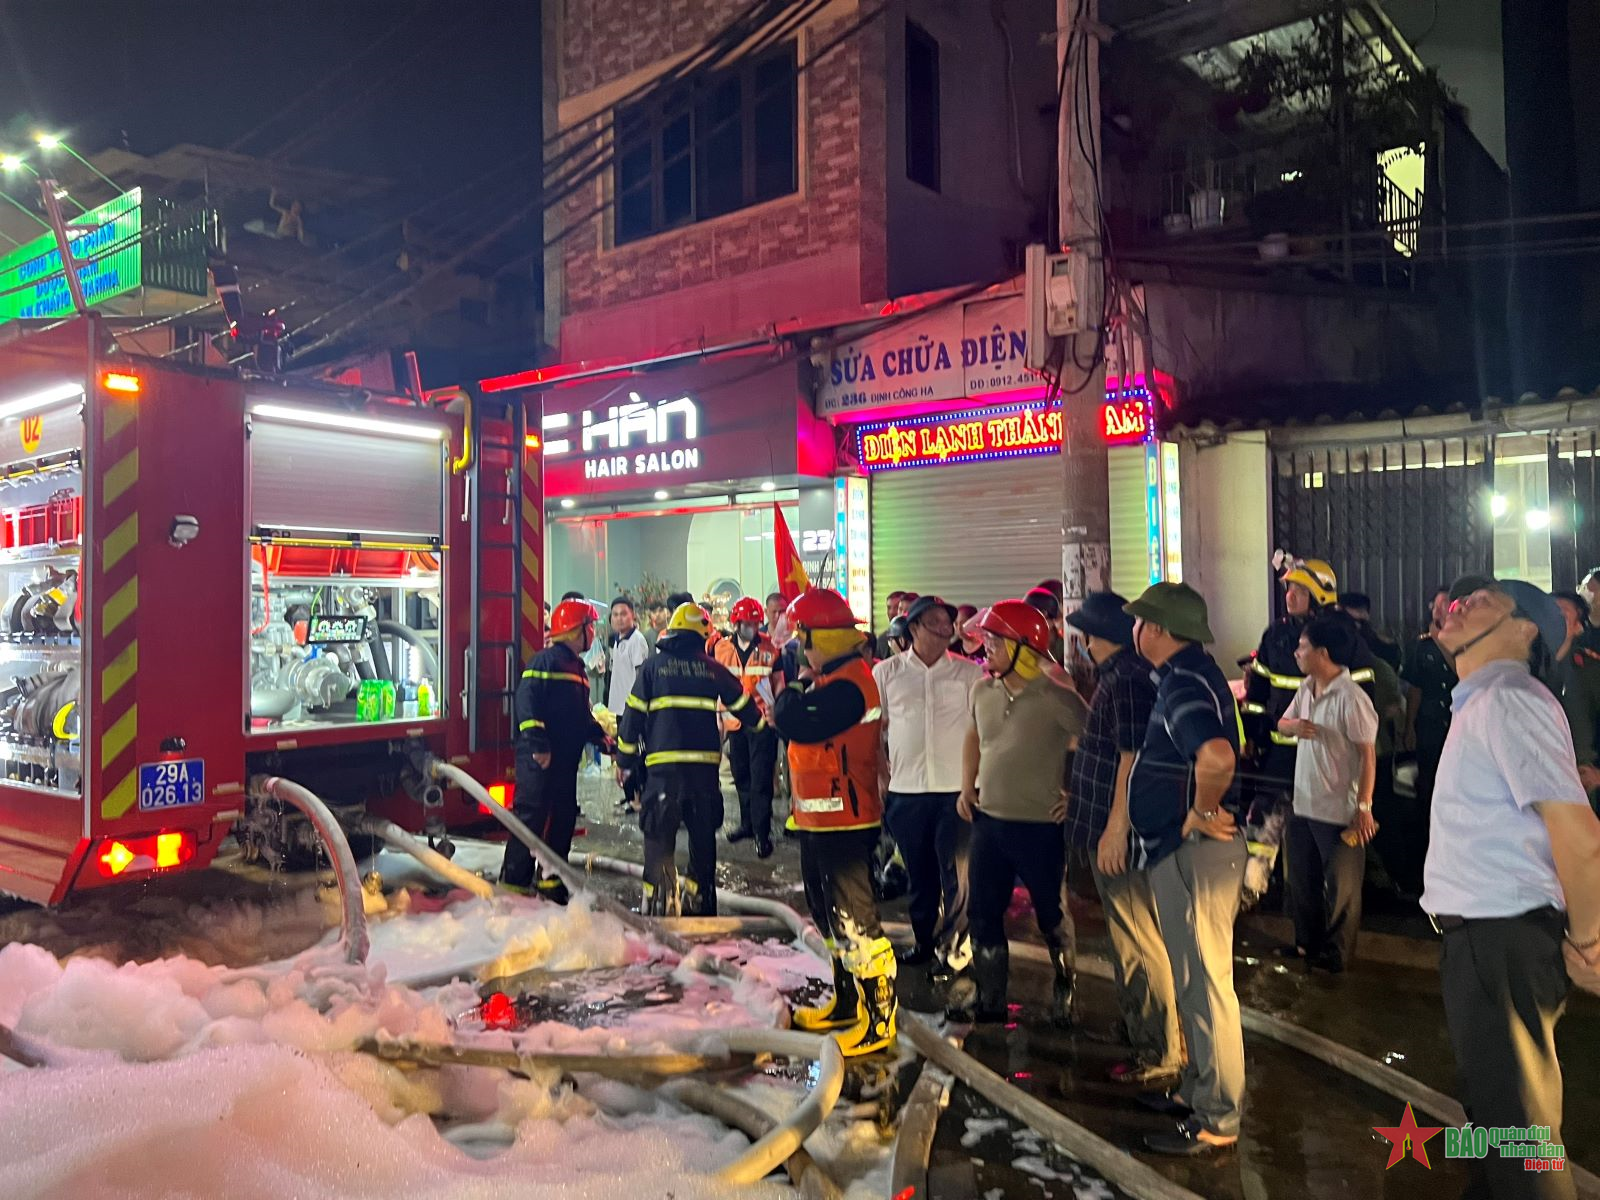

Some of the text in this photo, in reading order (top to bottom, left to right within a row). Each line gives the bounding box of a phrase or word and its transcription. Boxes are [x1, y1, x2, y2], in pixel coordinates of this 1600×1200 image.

[831, 323, 1027, 386] SỬA CHỮA ĐIỆN
[893, 387, 918, 400] CÔNG
[24, 415, 40, 444] 02
[584, 447, 699, 479] HAIR SALON
[156, 762, 189, 785] 29A
